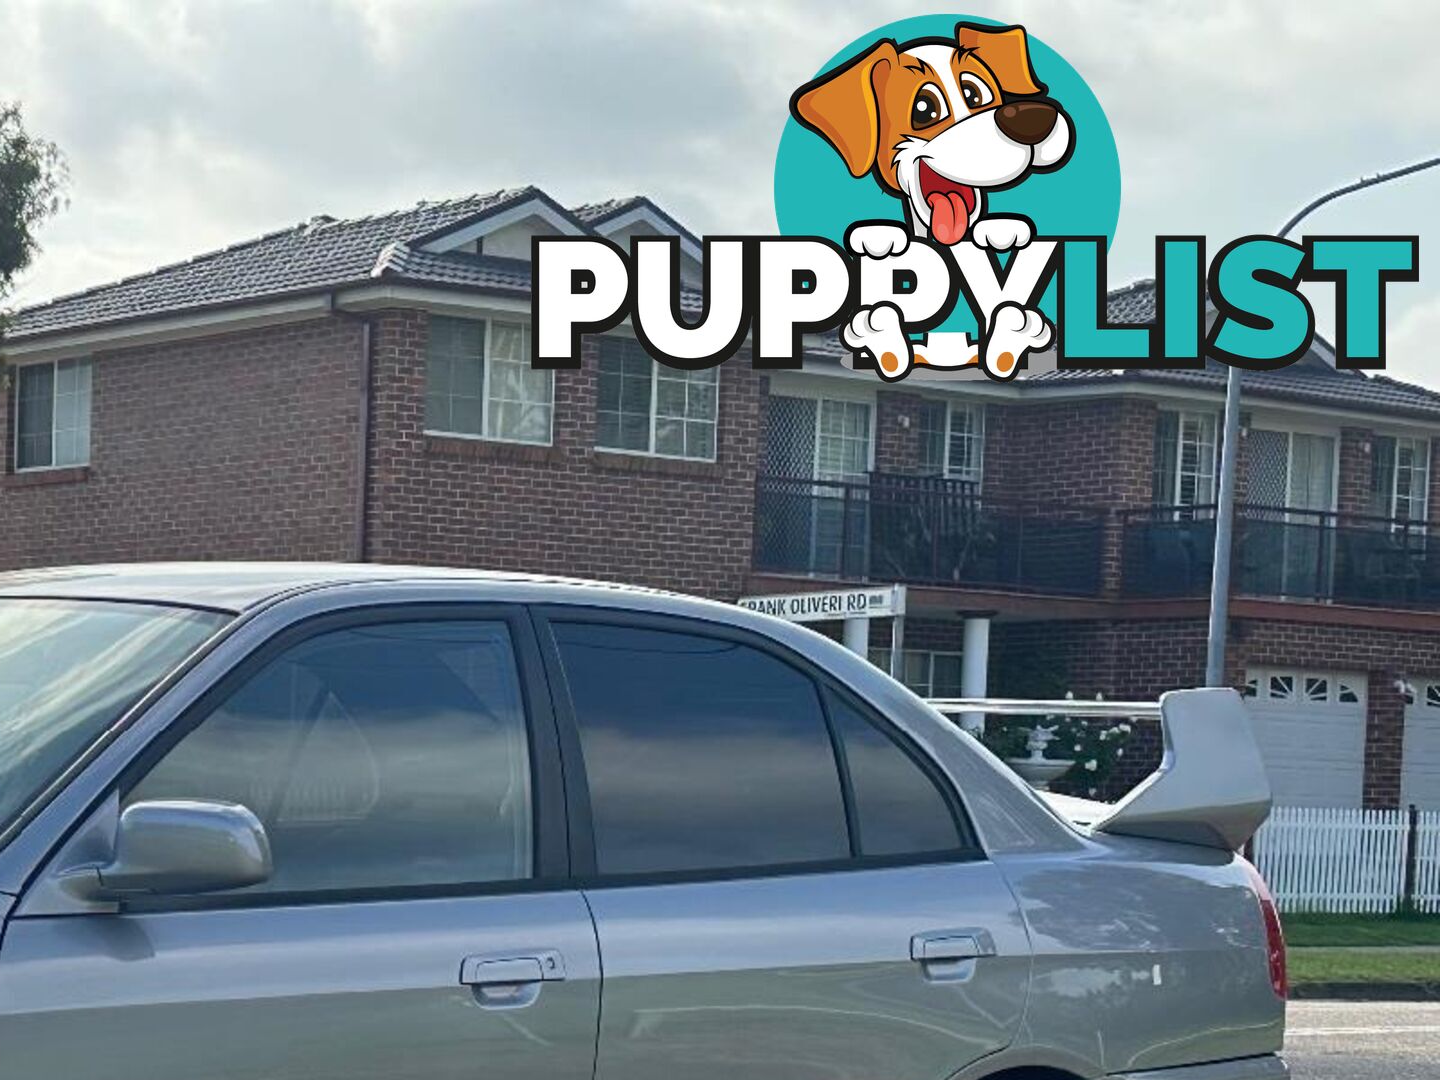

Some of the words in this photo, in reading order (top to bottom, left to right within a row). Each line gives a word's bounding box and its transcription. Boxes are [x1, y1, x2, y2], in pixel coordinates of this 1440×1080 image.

[741, 598, 786, 616] RANK
[791, 595, 842, 614] OLIVERI
[847, 593, 867, 611] RD
